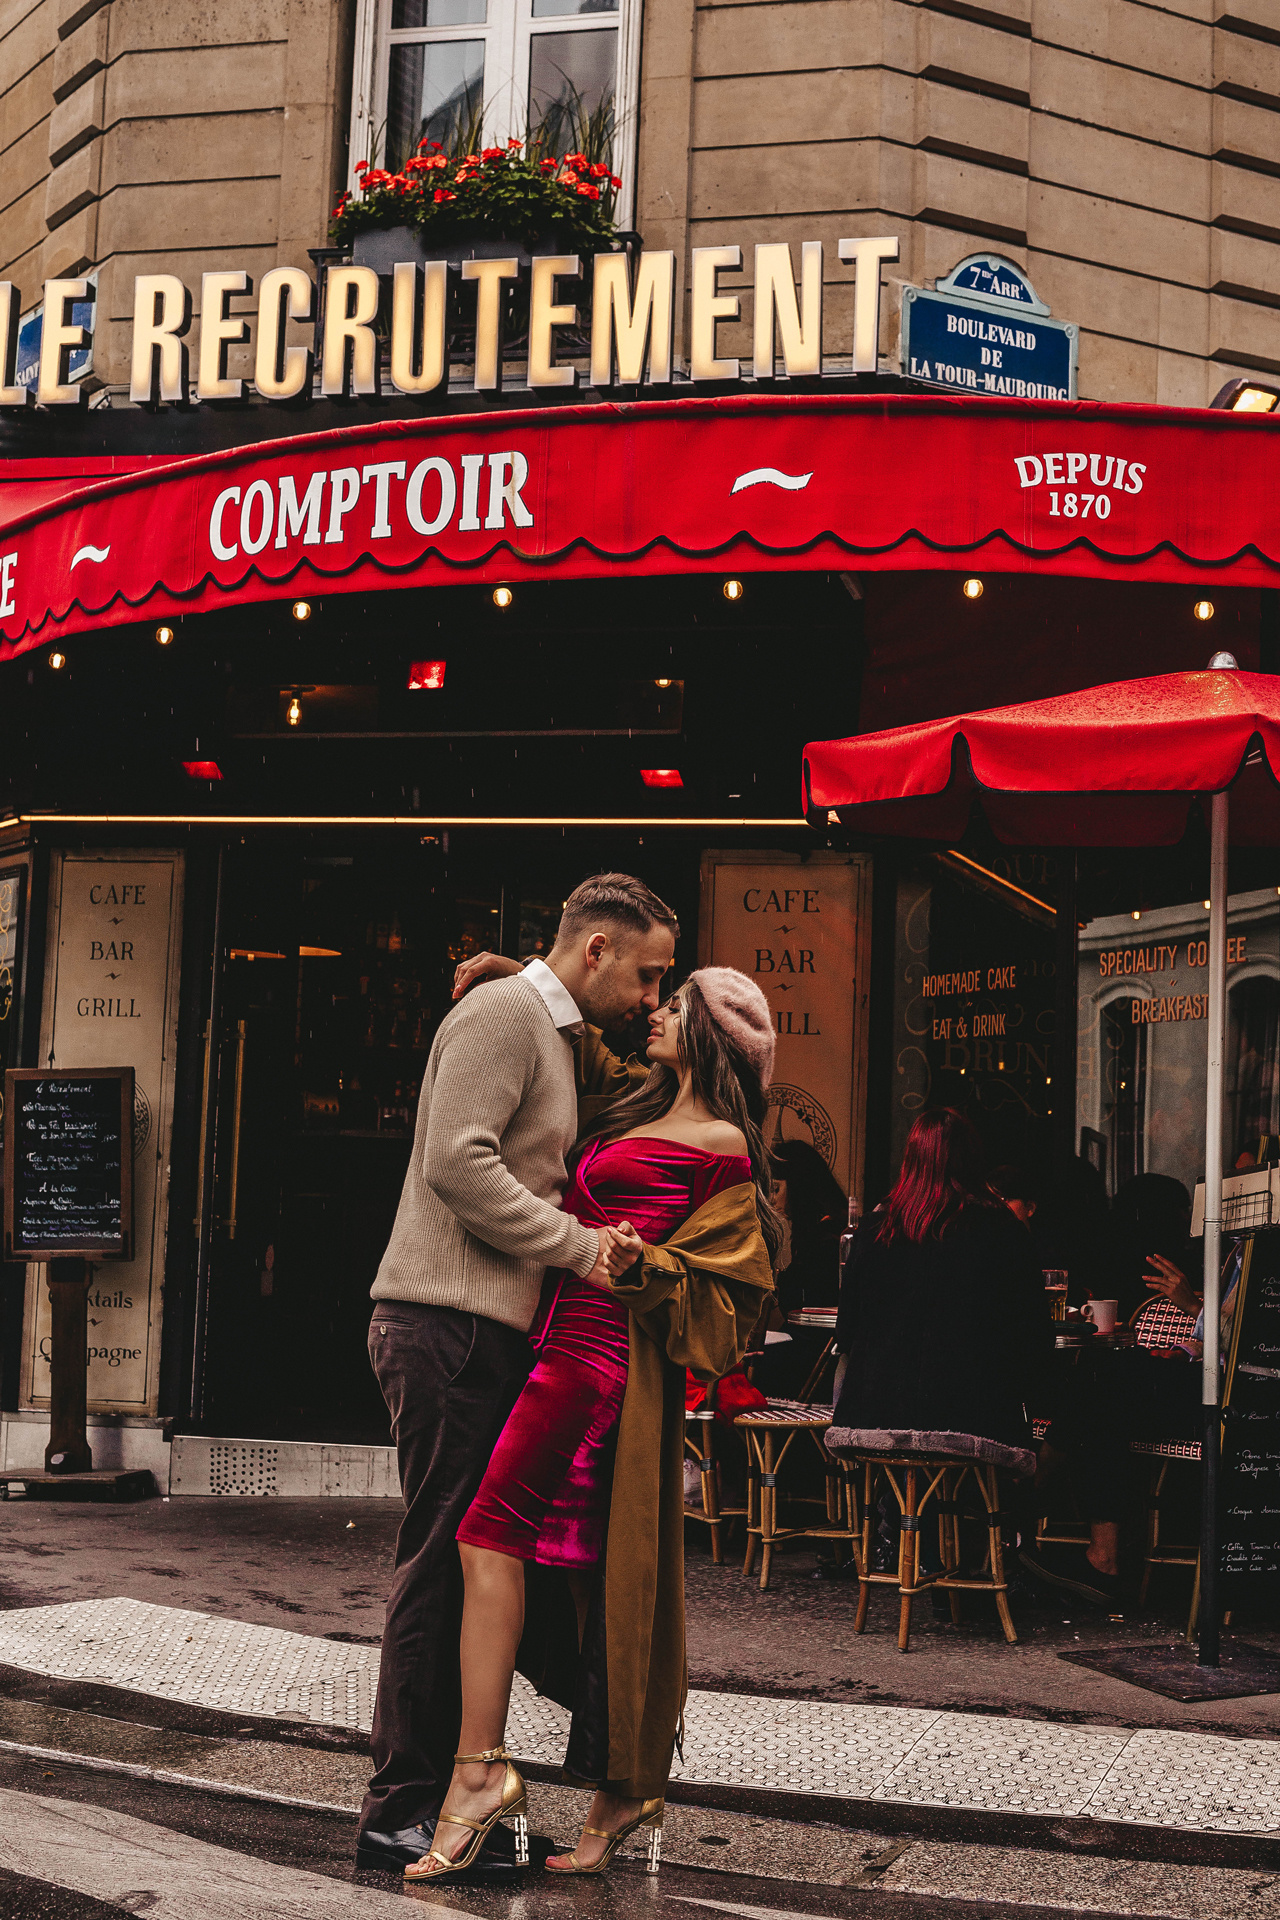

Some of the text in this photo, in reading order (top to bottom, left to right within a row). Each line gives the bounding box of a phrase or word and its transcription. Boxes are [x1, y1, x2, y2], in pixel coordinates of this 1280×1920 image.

[0, 236, 899, 405] LE RECRUTEMENT
[946, 313, 1037, 351] BOULEVARD
[980, 346, 1003, 369] DE
[910, 357, 1068, 400] LA TOUR-MAUBOURG
[1014, 452, 1148, 495] DEPUIS
[209, 451, 534, 562] COMPTOIR
[1049, 492, 1112, 519] 1870
[0, 551, 18, 619] E
[89, 884, 147, 905] CAFE
[743, 888, 821, 914] CAFE
[90, 941, 134, 961] BAR
[754, 948, 816, 974] BAR
[1099, 936, 1247, 977] SPECIALITY COEE
[922, 970, 981, 998] HOMEMADE
[987, 965, 1017, 990] CAKE
[77, 997, 142, 1018] GRILL
[1131, 994, 1209, 1025] BREAKFAST
[775, 1011, 821, 1036] ILL
[932, 1013, 1007, 1041] EAT & DRINK
[39, 1336, 142, 1368] Cpagne
